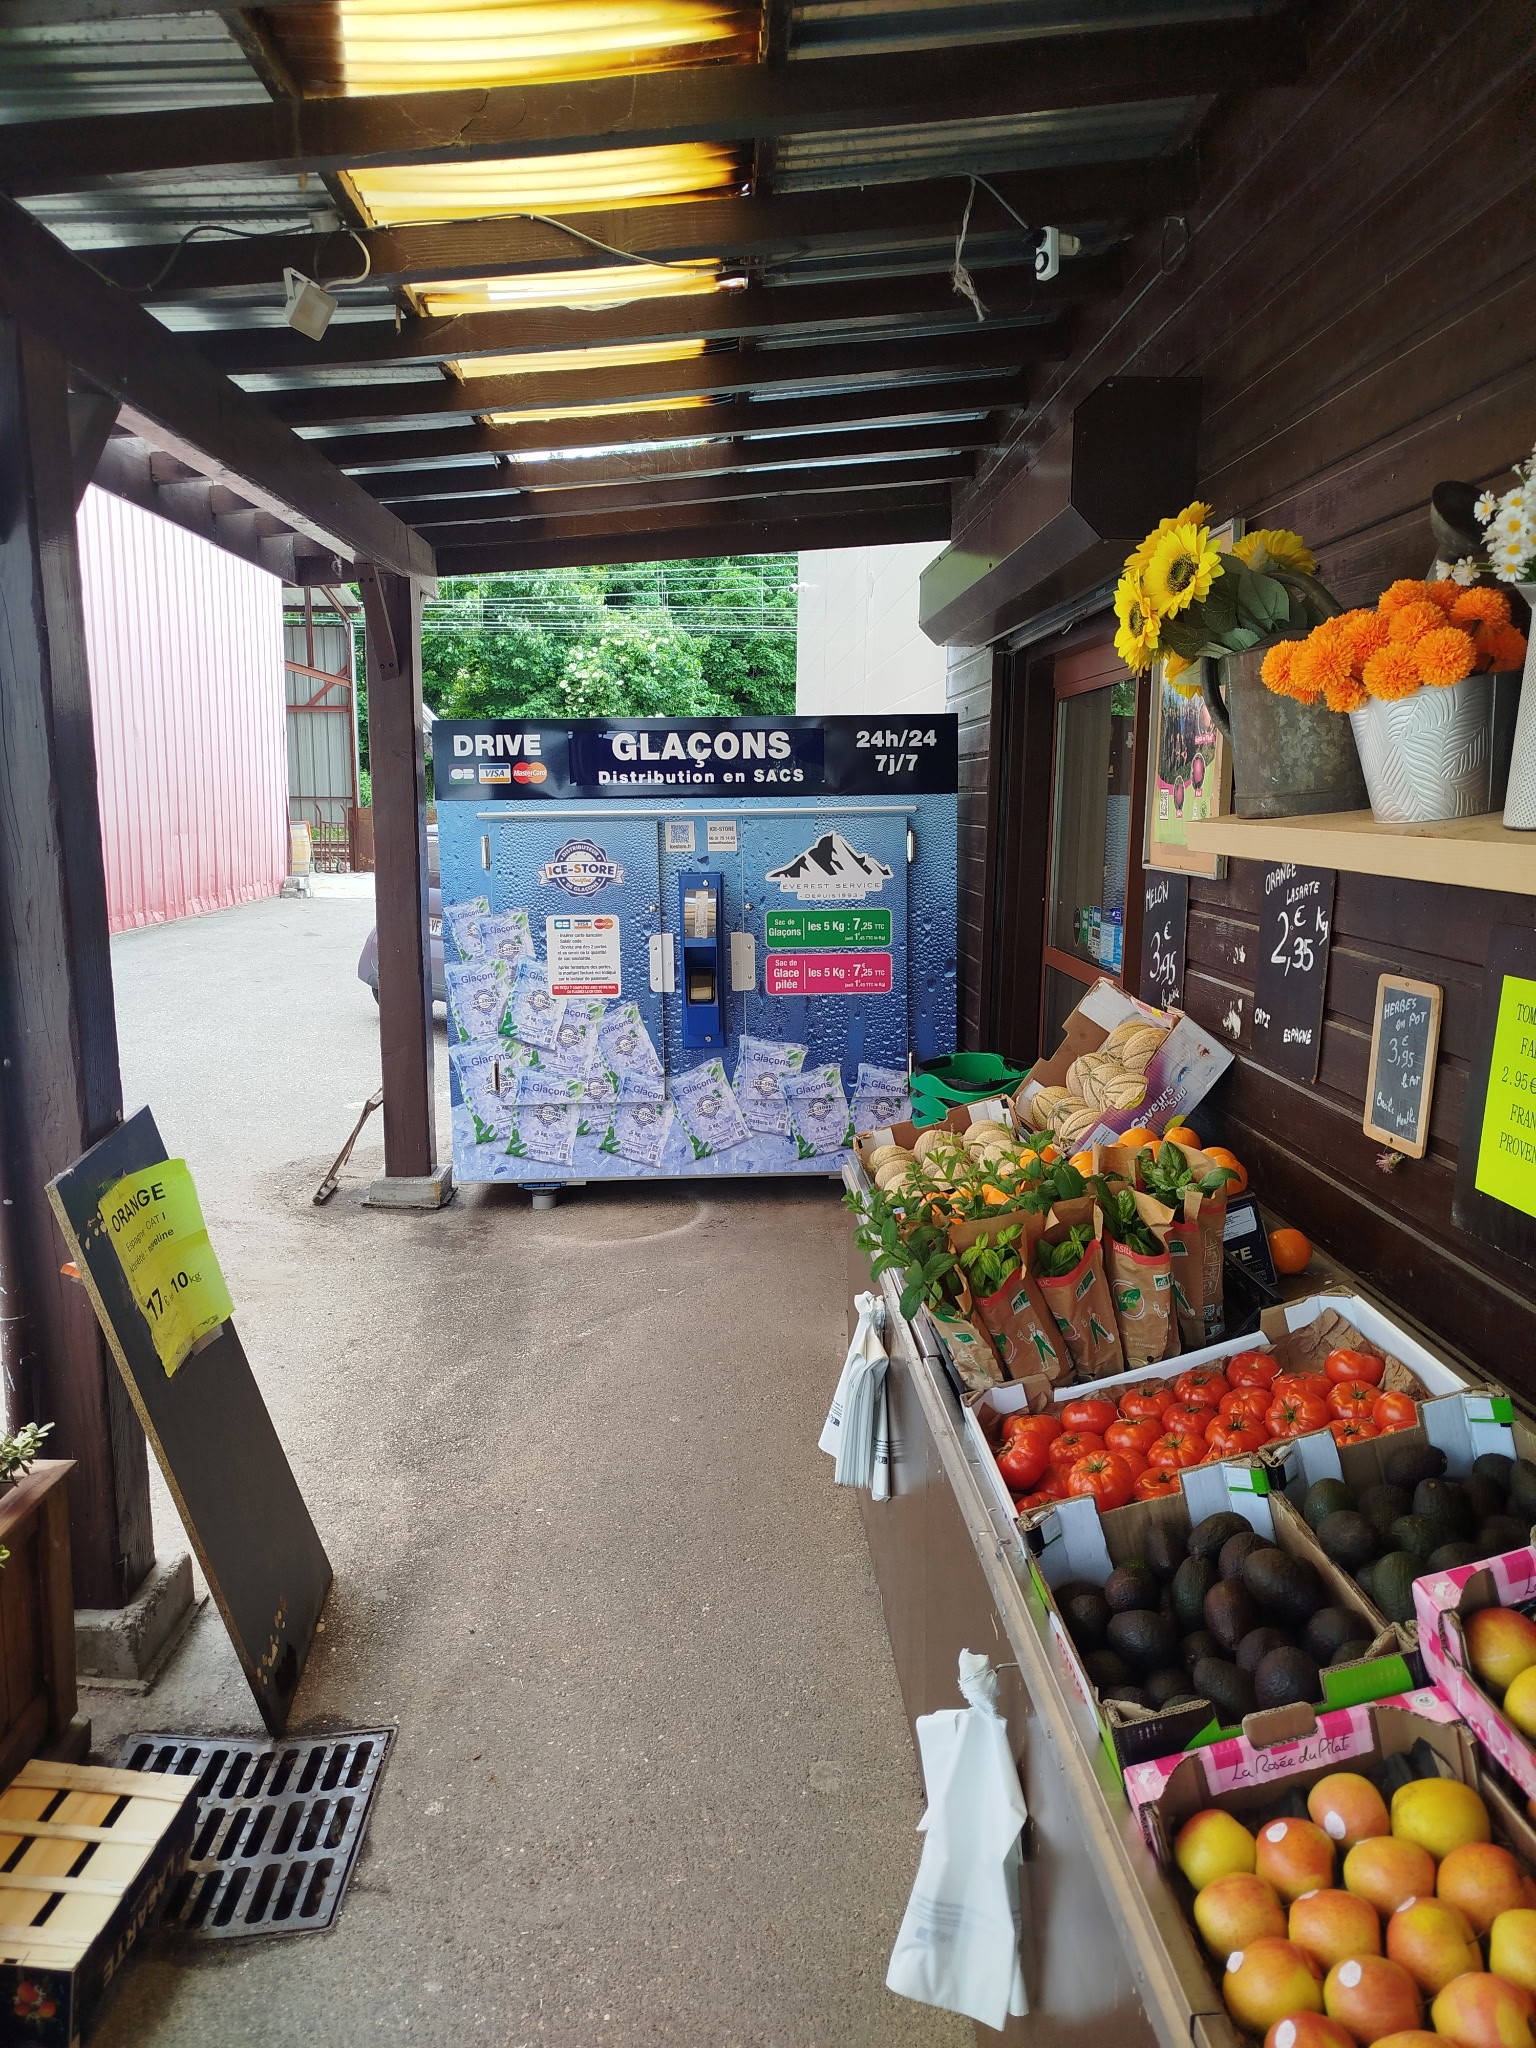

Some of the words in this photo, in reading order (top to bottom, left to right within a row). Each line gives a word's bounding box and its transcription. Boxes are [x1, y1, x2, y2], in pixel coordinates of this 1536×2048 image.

[453, 734, 542, 757] DRIVE
[855, 729, 938, 748] 24h/24
[611, 731, 792, 768] GLAÇONS
[484, 769, 506, 778] VISA
[513, 769, 547, 777] MasterCard
[874, 754, 919, 776] 7j/7
[598, 770, 715, 784] Distribution
[722, 771, 746, 783] en
[753, 768, 805, 783] SACS
[561, 844, 600, 859] DISTRIBUTEUR
[548, 863, 615, 876] ICE-STORE
[1265, 863, 1297, 895] ORANGE
[1145, 880, 1169, 912] MELON
[1286, 881, 1321, 906] LASARTE
[774, 918, 786, 926] Sac
[787, 918, 795, 926] de
[808, 921, 822, 930] les
[823, 921, 830, 930] 5
[832, 920, 845, 933] Kg
[852, 917, 873, 932] 7,25
[768, 927, 802, 939] Glaçons
[774, 959, 787, 967] Sac
[773, 968, 800, 978] Glace
[808, 968, 822, 977] les
[824, 968, 830, 977] 5
[832, 967, 845, 980] Kg
[775, 980, 798, 991] pilée
[1384, 997, 1418, 1020] HERBES
[602, 1018, 633, 1035] Glaçons
[1409, 1011, 1427, 1027] POT
[1283, 1028, 1313, 1045] ESPAGNE
[753, 1052, 791, 1068] Glaçons
[682, 1076, 717, 1095] Glaçons
[796, 1080, 832, 1096] Glaçons
[871, 1079, 908, 1096] Glaçons
[1501, 1065, 1536, 1095] 2.95€
[532, 1083, 571, 1098] Glaçons
[1169, 1085, 1188, 1109] Sud
[1130, 1085, 1175, 1129] Saveurs
[111, 1181, 167, 1233] ORANGE
[145, 1213, 161, 1231] CAT
[146, 1287, 164, 1321] 17
[170, 1271, 189, 1294] 10
[188, 1271, 202, 1284] kg
[1232, 1763, 1252, 1782] La
[1255, 1754, 1295, 1774] Rosée
[1298, 1747, 1318, 1764] du
